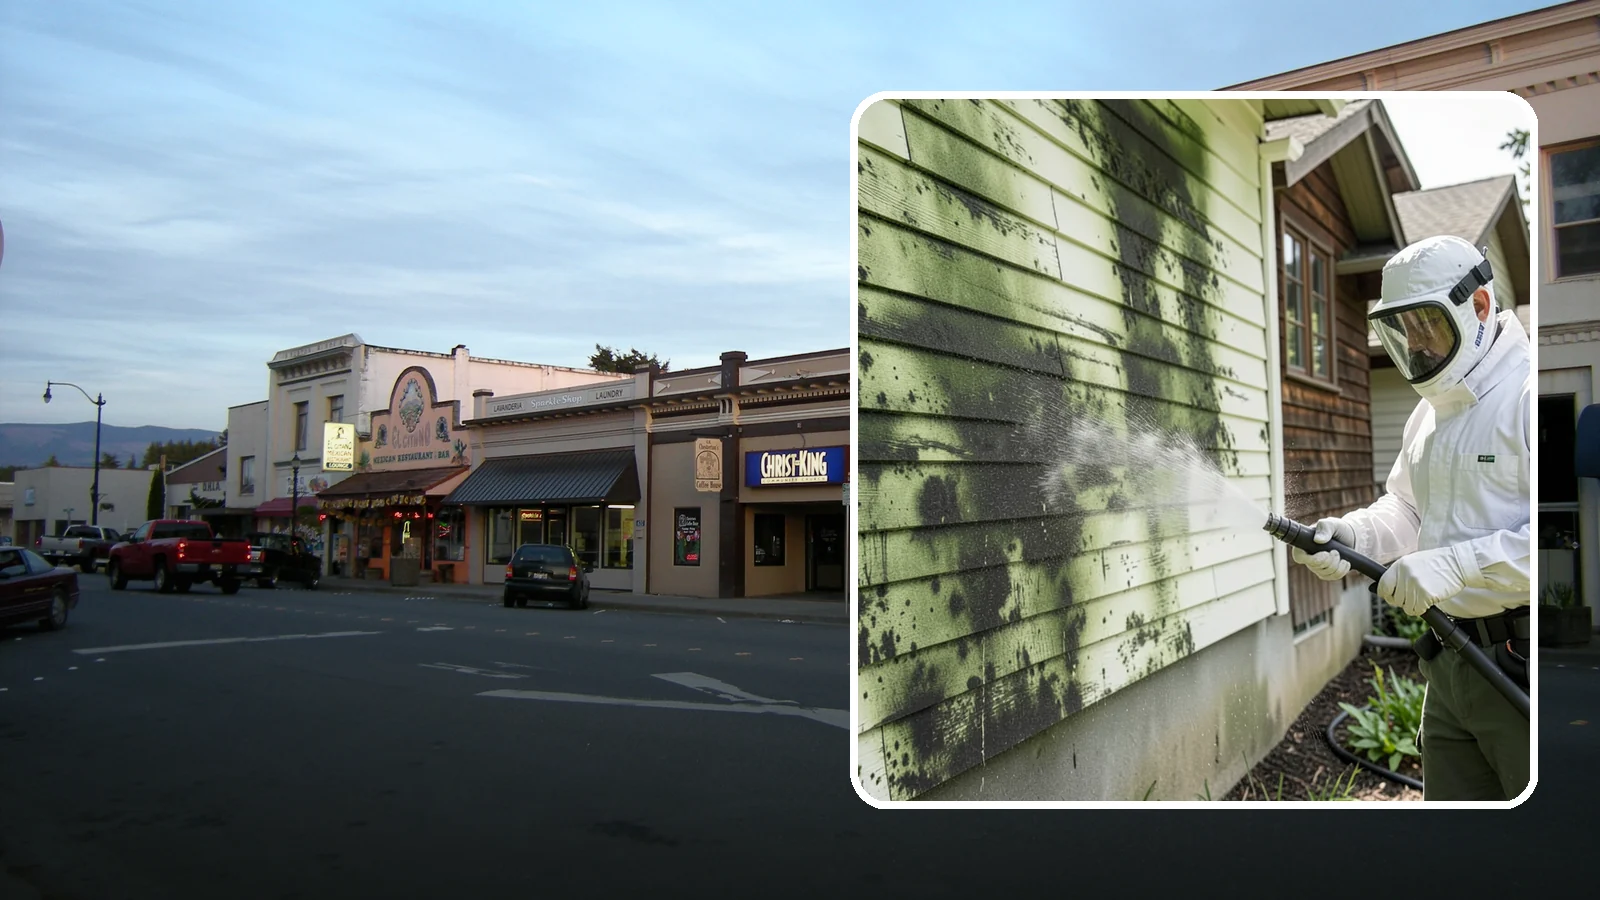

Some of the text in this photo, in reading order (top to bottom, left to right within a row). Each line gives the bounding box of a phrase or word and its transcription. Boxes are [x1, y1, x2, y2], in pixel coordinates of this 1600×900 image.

[595, 389, 624, 400] LAUNDRY
[493, 394, 582, 412] LAVANDERIA Sparkle Shop
[374, 450, 449, 463] MEXICAN RESTAURANT BAR
[761, 450, 827, 478] CHRIST KING
